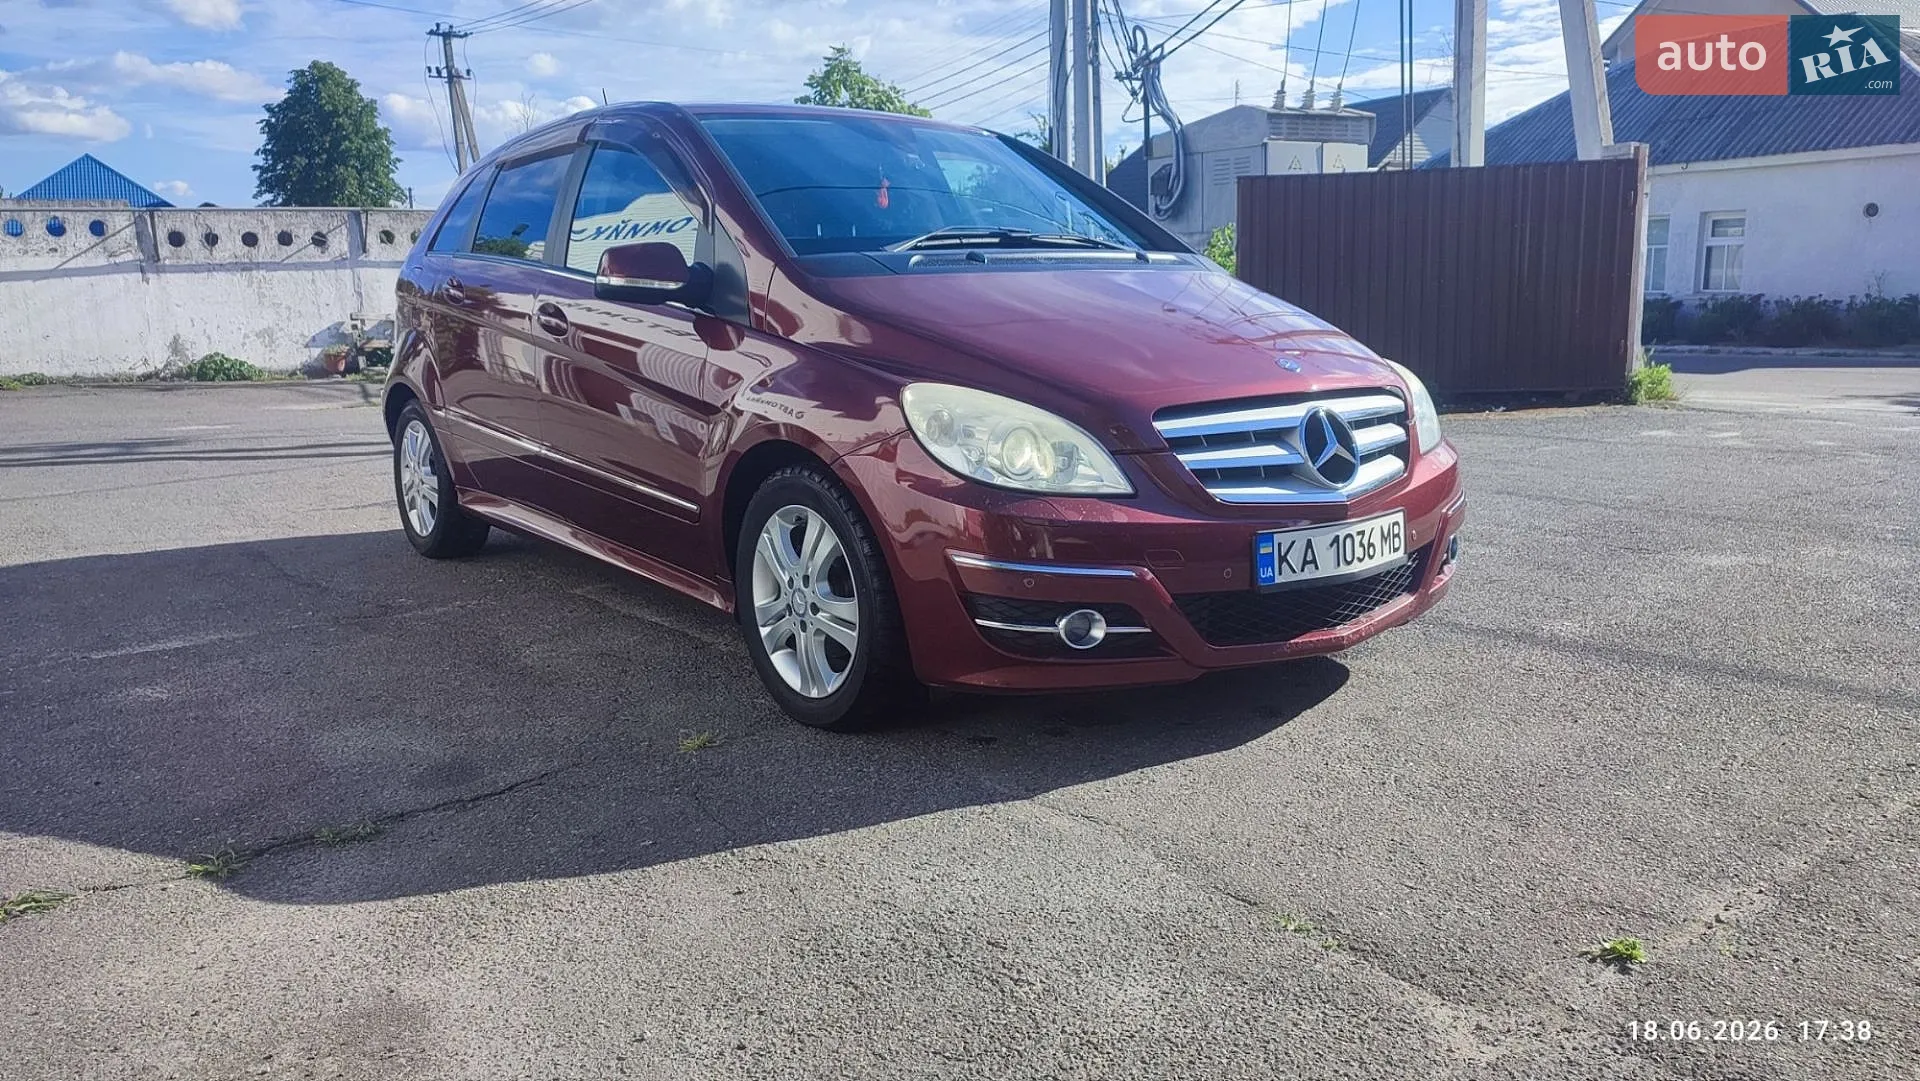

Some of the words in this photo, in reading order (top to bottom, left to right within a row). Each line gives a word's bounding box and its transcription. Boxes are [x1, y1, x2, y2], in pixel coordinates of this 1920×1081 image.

[1277, 538, 1320, 576] KA
[1328, 527, 1377, 568] 1036
[1380, 520, 1401, 557] MB
[1260, 568, 1274, 578] UA
